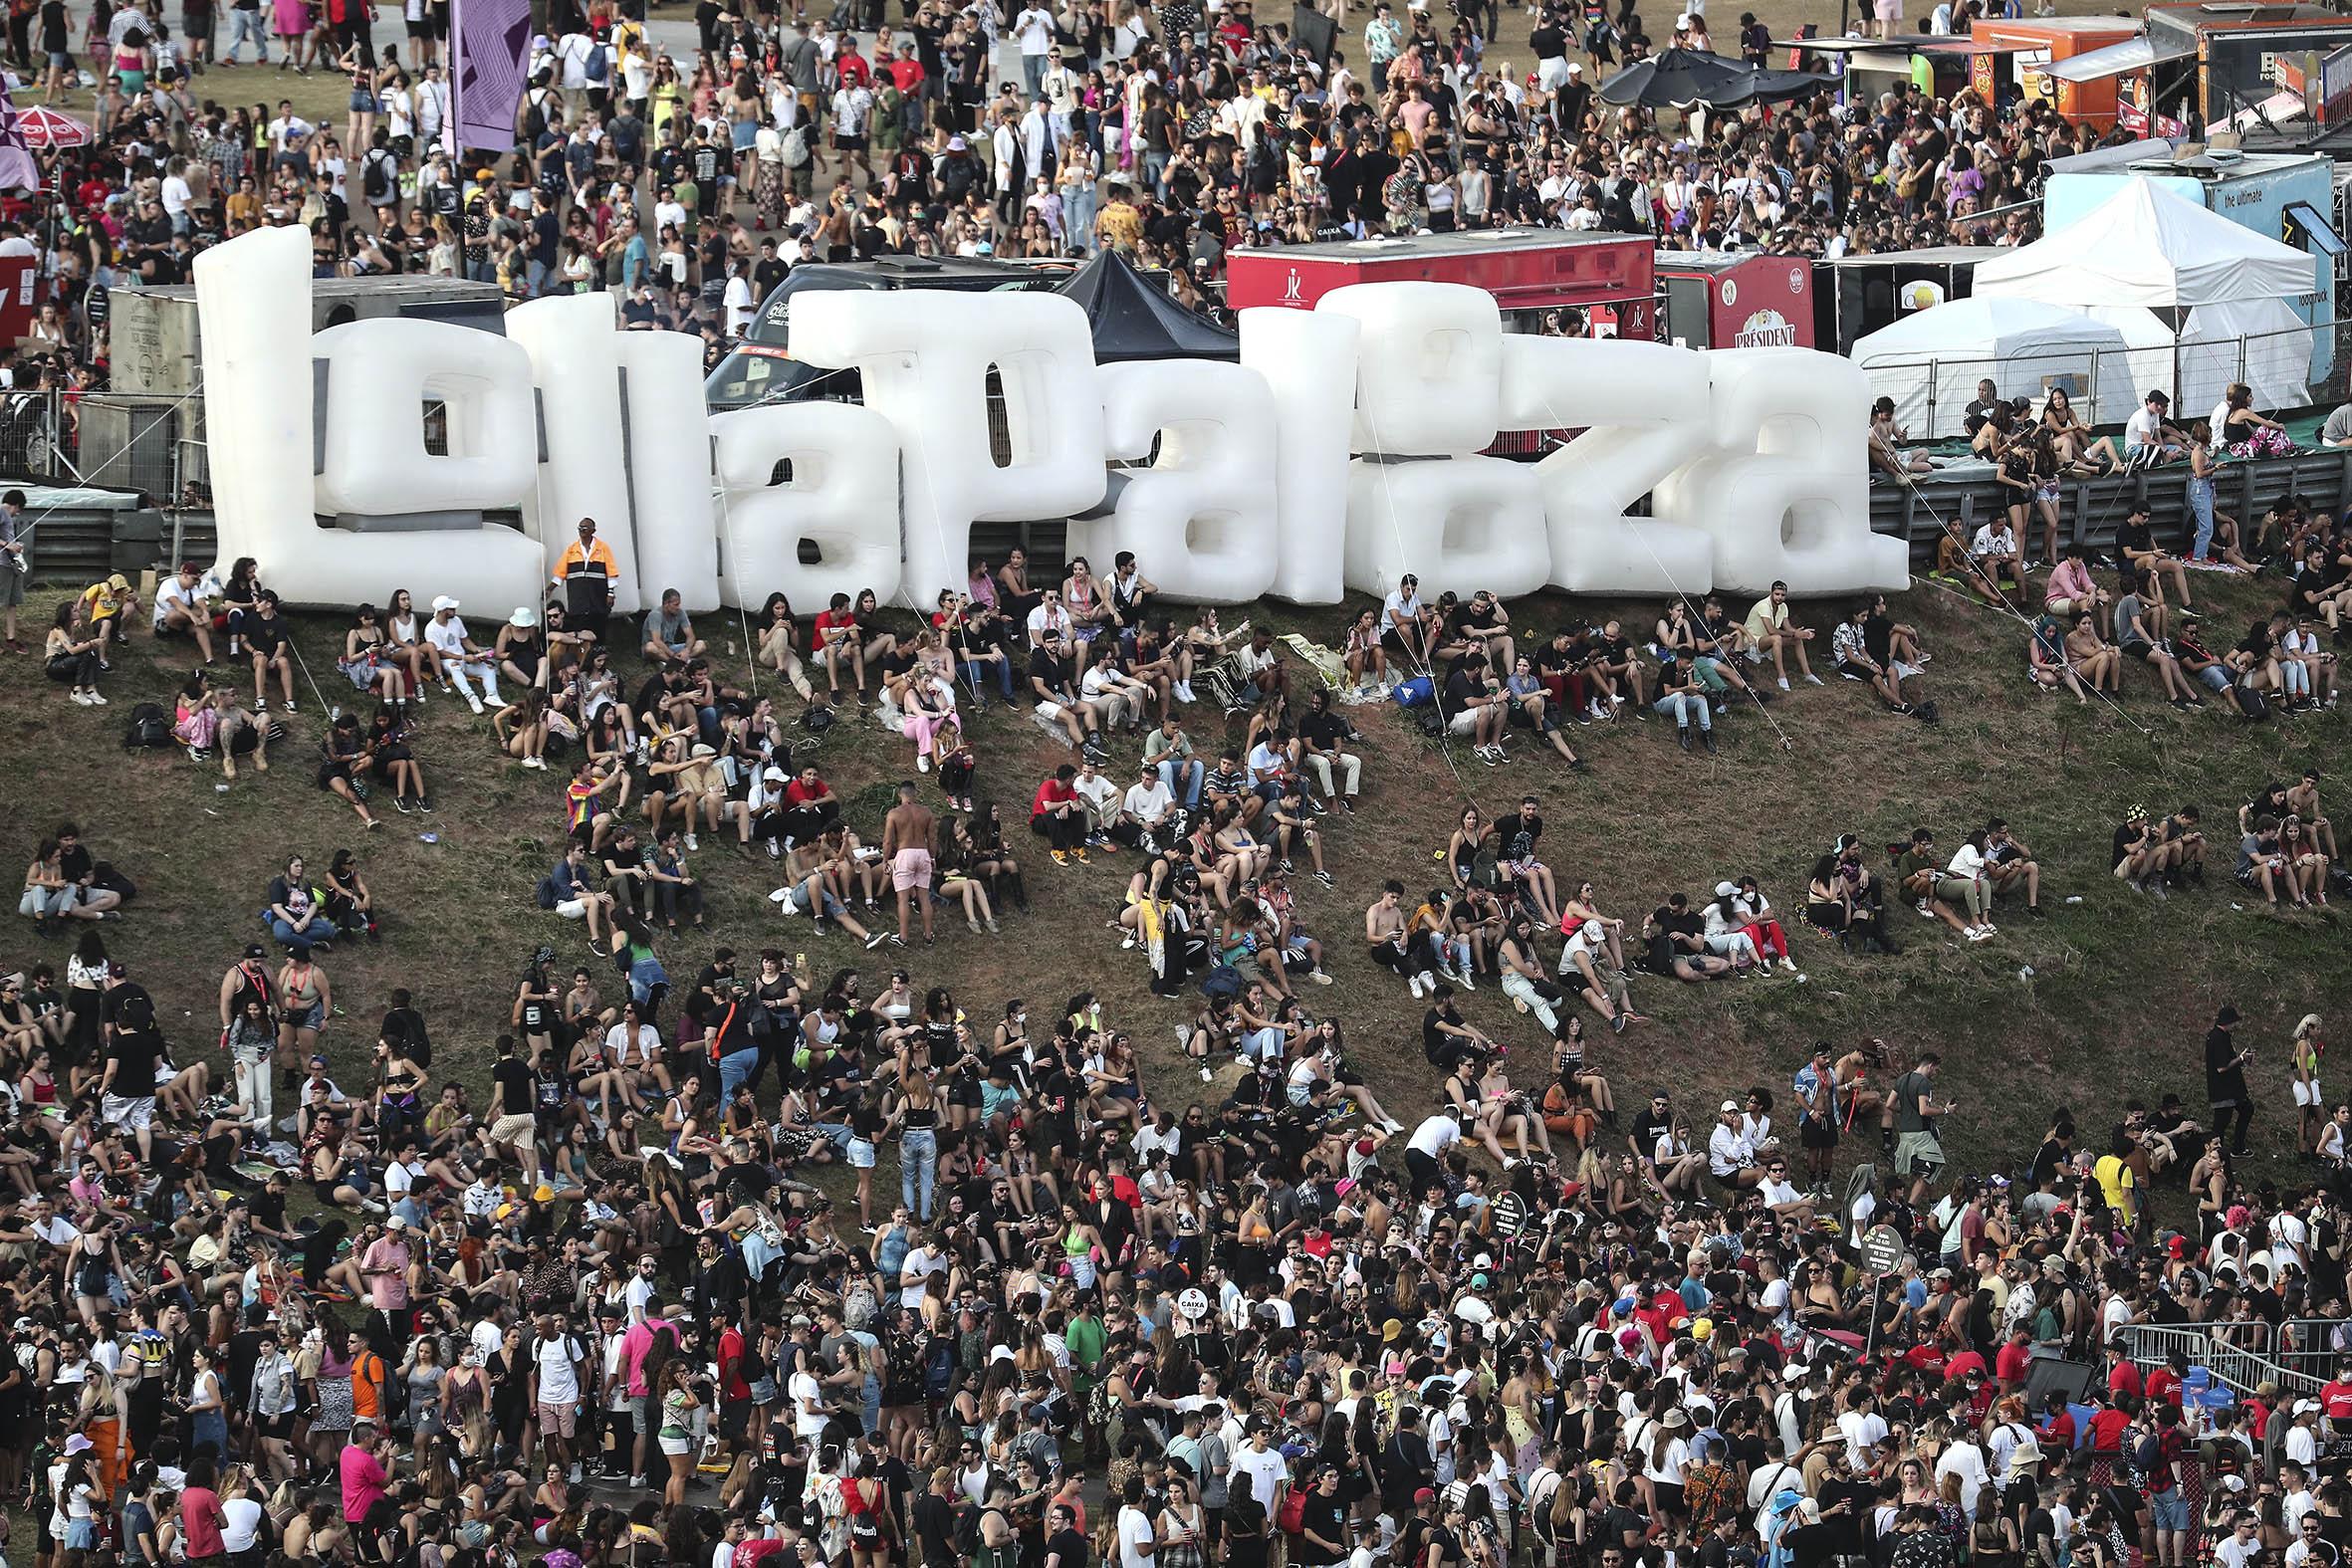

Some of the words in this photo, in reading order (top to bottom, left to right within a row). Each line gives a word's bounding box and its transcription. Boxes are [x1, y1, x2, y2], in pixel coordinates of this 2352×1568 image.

[2225, 194, 2235, 208] the
[2237, 189, 2262, 206] ultimate
[1316, 227, 1340, 237] CAIXA
[1736, 326, 1794, 348] PRÉSIDENT
